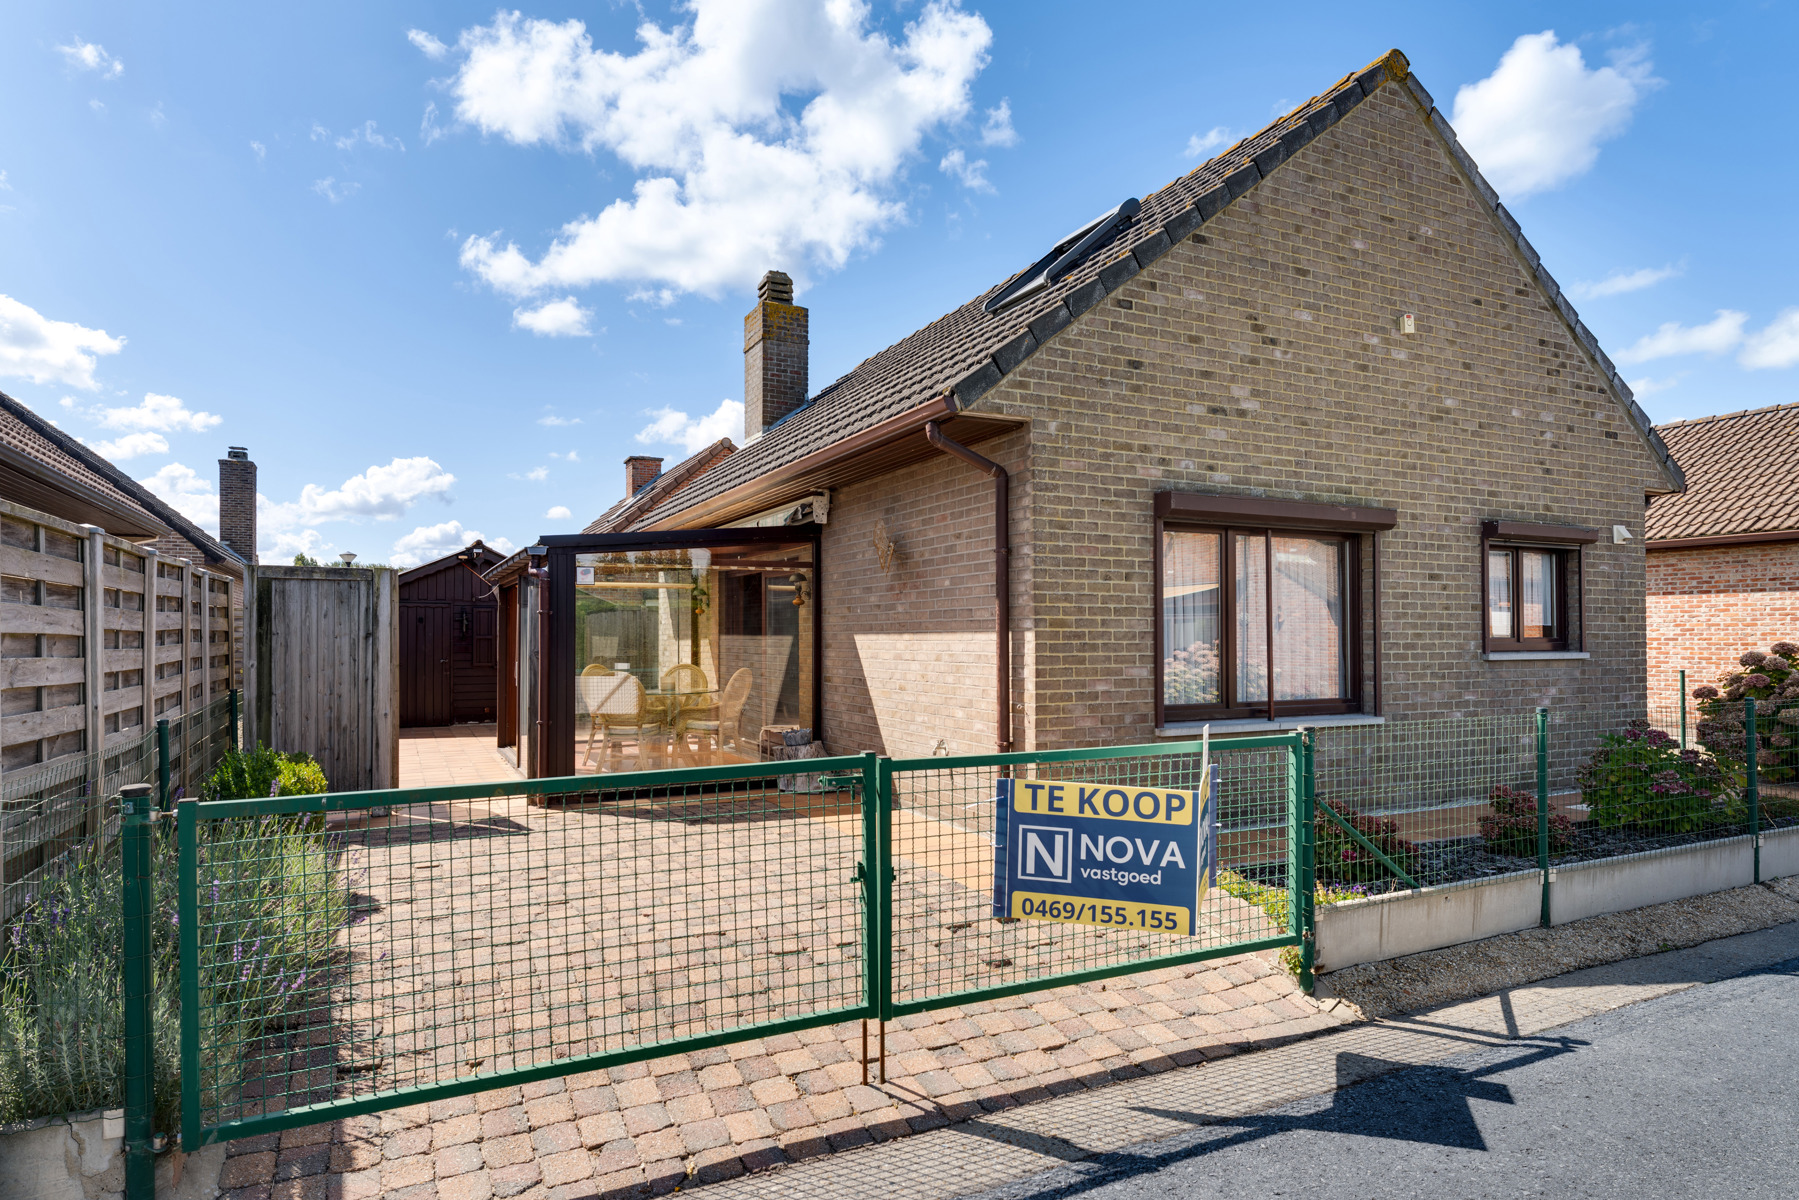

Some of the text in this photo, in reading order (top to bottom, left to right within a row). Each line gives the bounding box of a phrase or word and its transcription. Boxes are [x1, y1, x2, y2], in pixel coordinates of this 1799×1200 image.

[1024, 783, 1065, 813] TE
[1078, 787, 1186, 821] KOOP
[1025, 831, 1064, 877] N
[1080, 833, 1186, 869] NOVA
[1080, 867, 1162, 886] vastgoed
[1021, 897, 1178, 930] 0469/155.155
